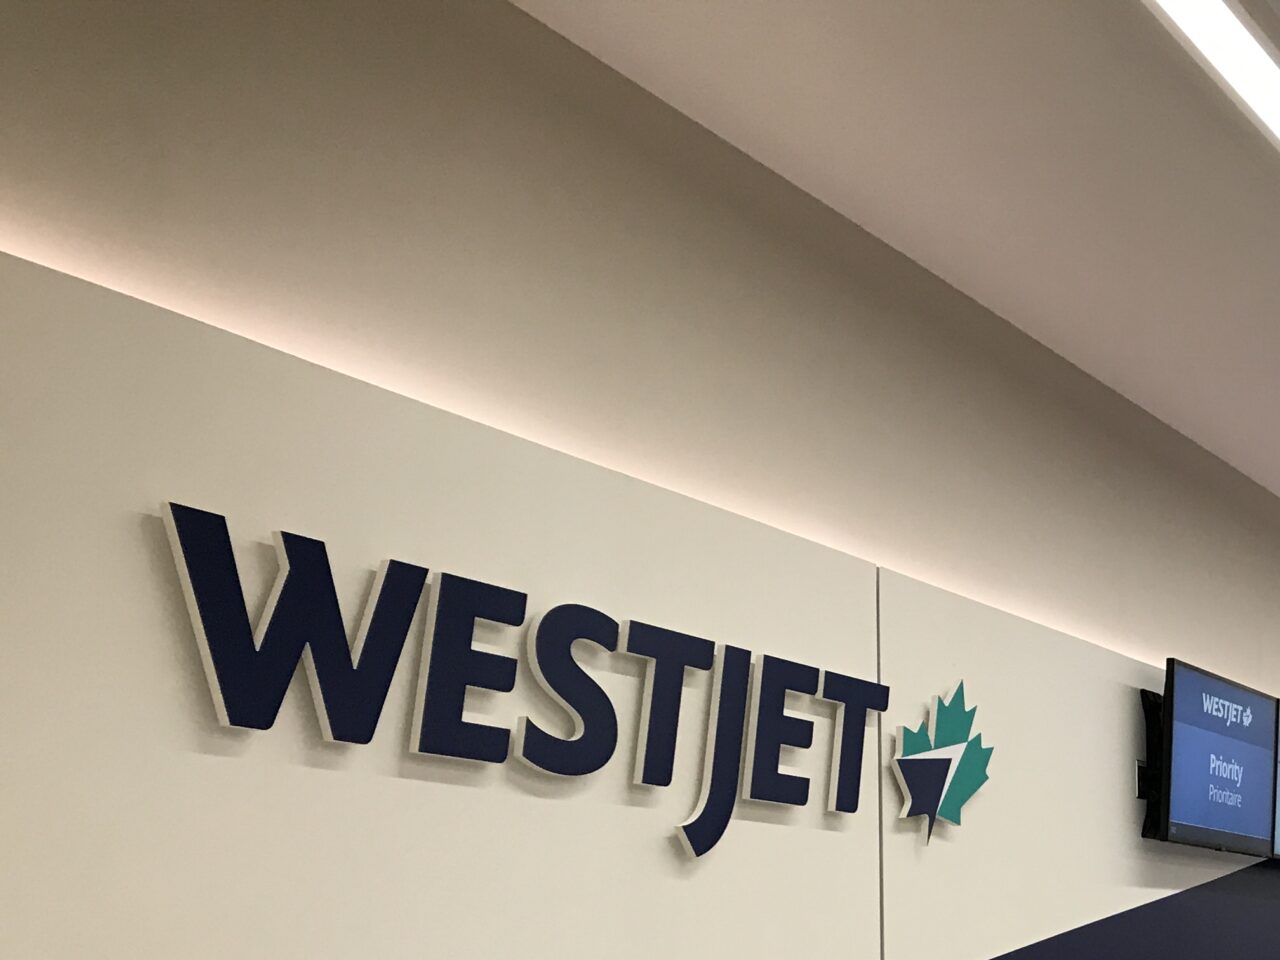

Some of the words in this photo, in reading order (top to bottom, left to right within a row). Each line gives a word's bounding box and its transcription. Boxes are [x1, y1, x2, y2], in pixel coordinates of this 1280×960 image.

[167, 502, 891, 858] WESTJET
[1202, 692, 1244, 727] WESTJET
[1209, 753, 1244, 788] Priority
[1208, 783, 1242, 808] Prioritaire
